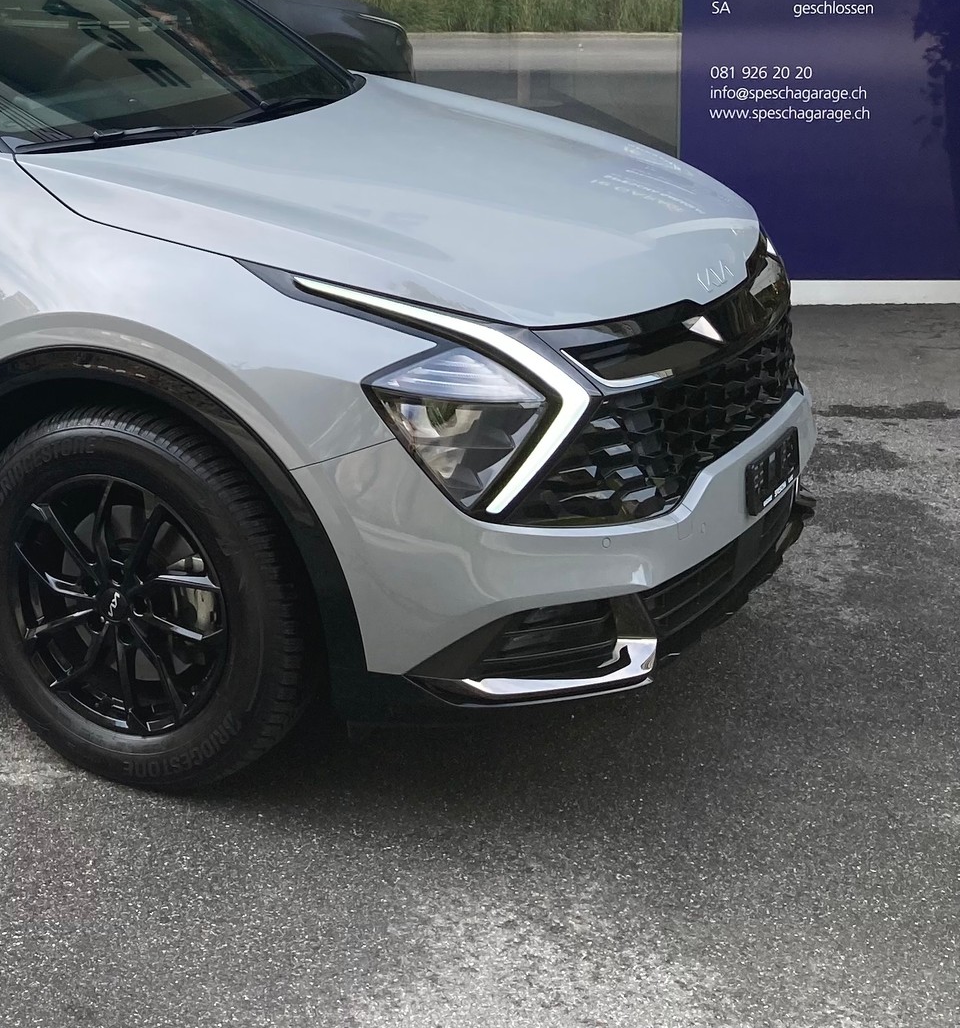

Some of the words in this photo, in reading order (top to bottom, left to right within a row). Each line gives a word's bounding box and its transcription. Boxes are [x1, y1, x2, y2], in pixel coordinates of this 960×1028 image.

[711, 1, 731, 15] SA
[793, 0, 874, 18] geschlossen
[710, 66, 735, 79] 081
[741, 66, 768, 79] 926
[772, 66, 790, 79] 20
[794, 66, 813, 80] 20
[710, 85, 867, 103] info@speschagarage.ch
[709, 105, 870, 123] www.speschagarage.ch
